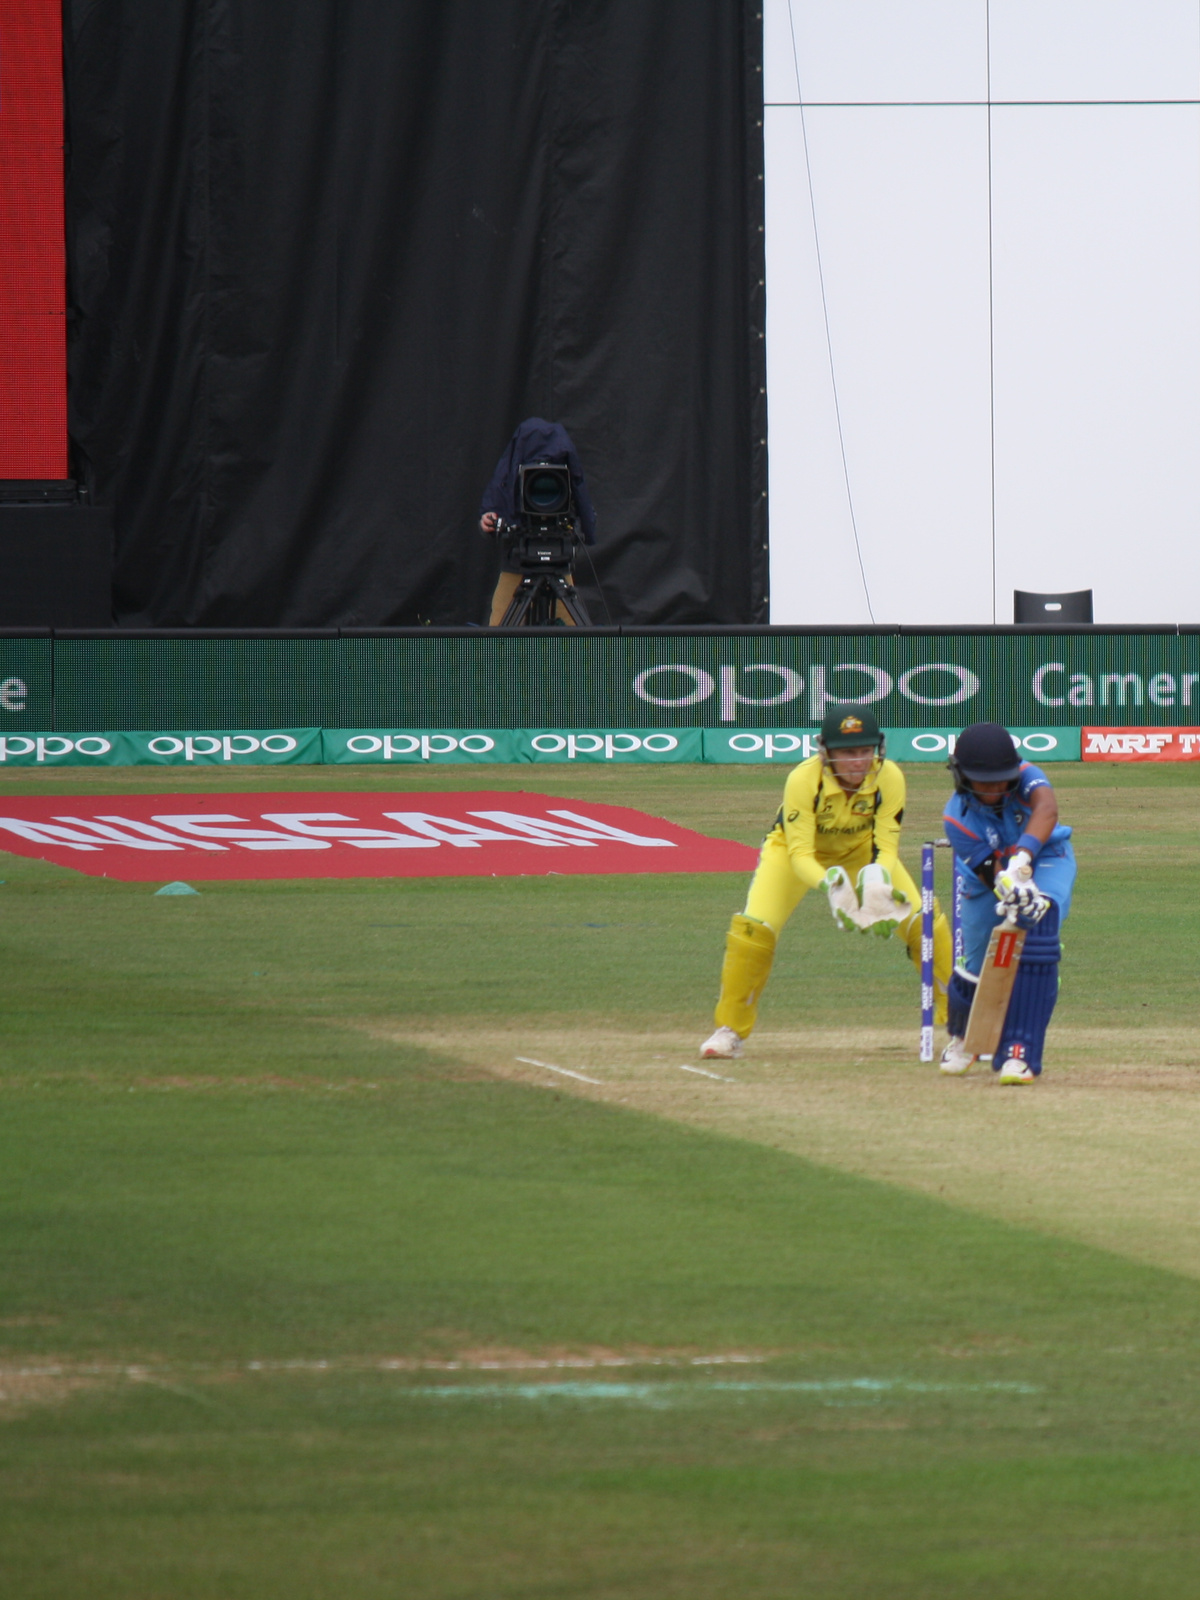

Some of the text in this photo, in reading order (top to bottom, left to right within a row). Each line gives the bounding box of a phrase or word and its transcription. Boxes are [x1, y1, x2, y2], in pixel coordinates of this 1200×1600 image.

[632, 663, 980, 722] oppo
[148, 734, 297, 761] oppo
[347, 735, 494, 759] oppo
[531, 733, 678, 758] oppo
[728, 733, 821, 758] opp
[1085, 733, 1172, 753] MRF
[0, 810, 678, 850] NISSAN
